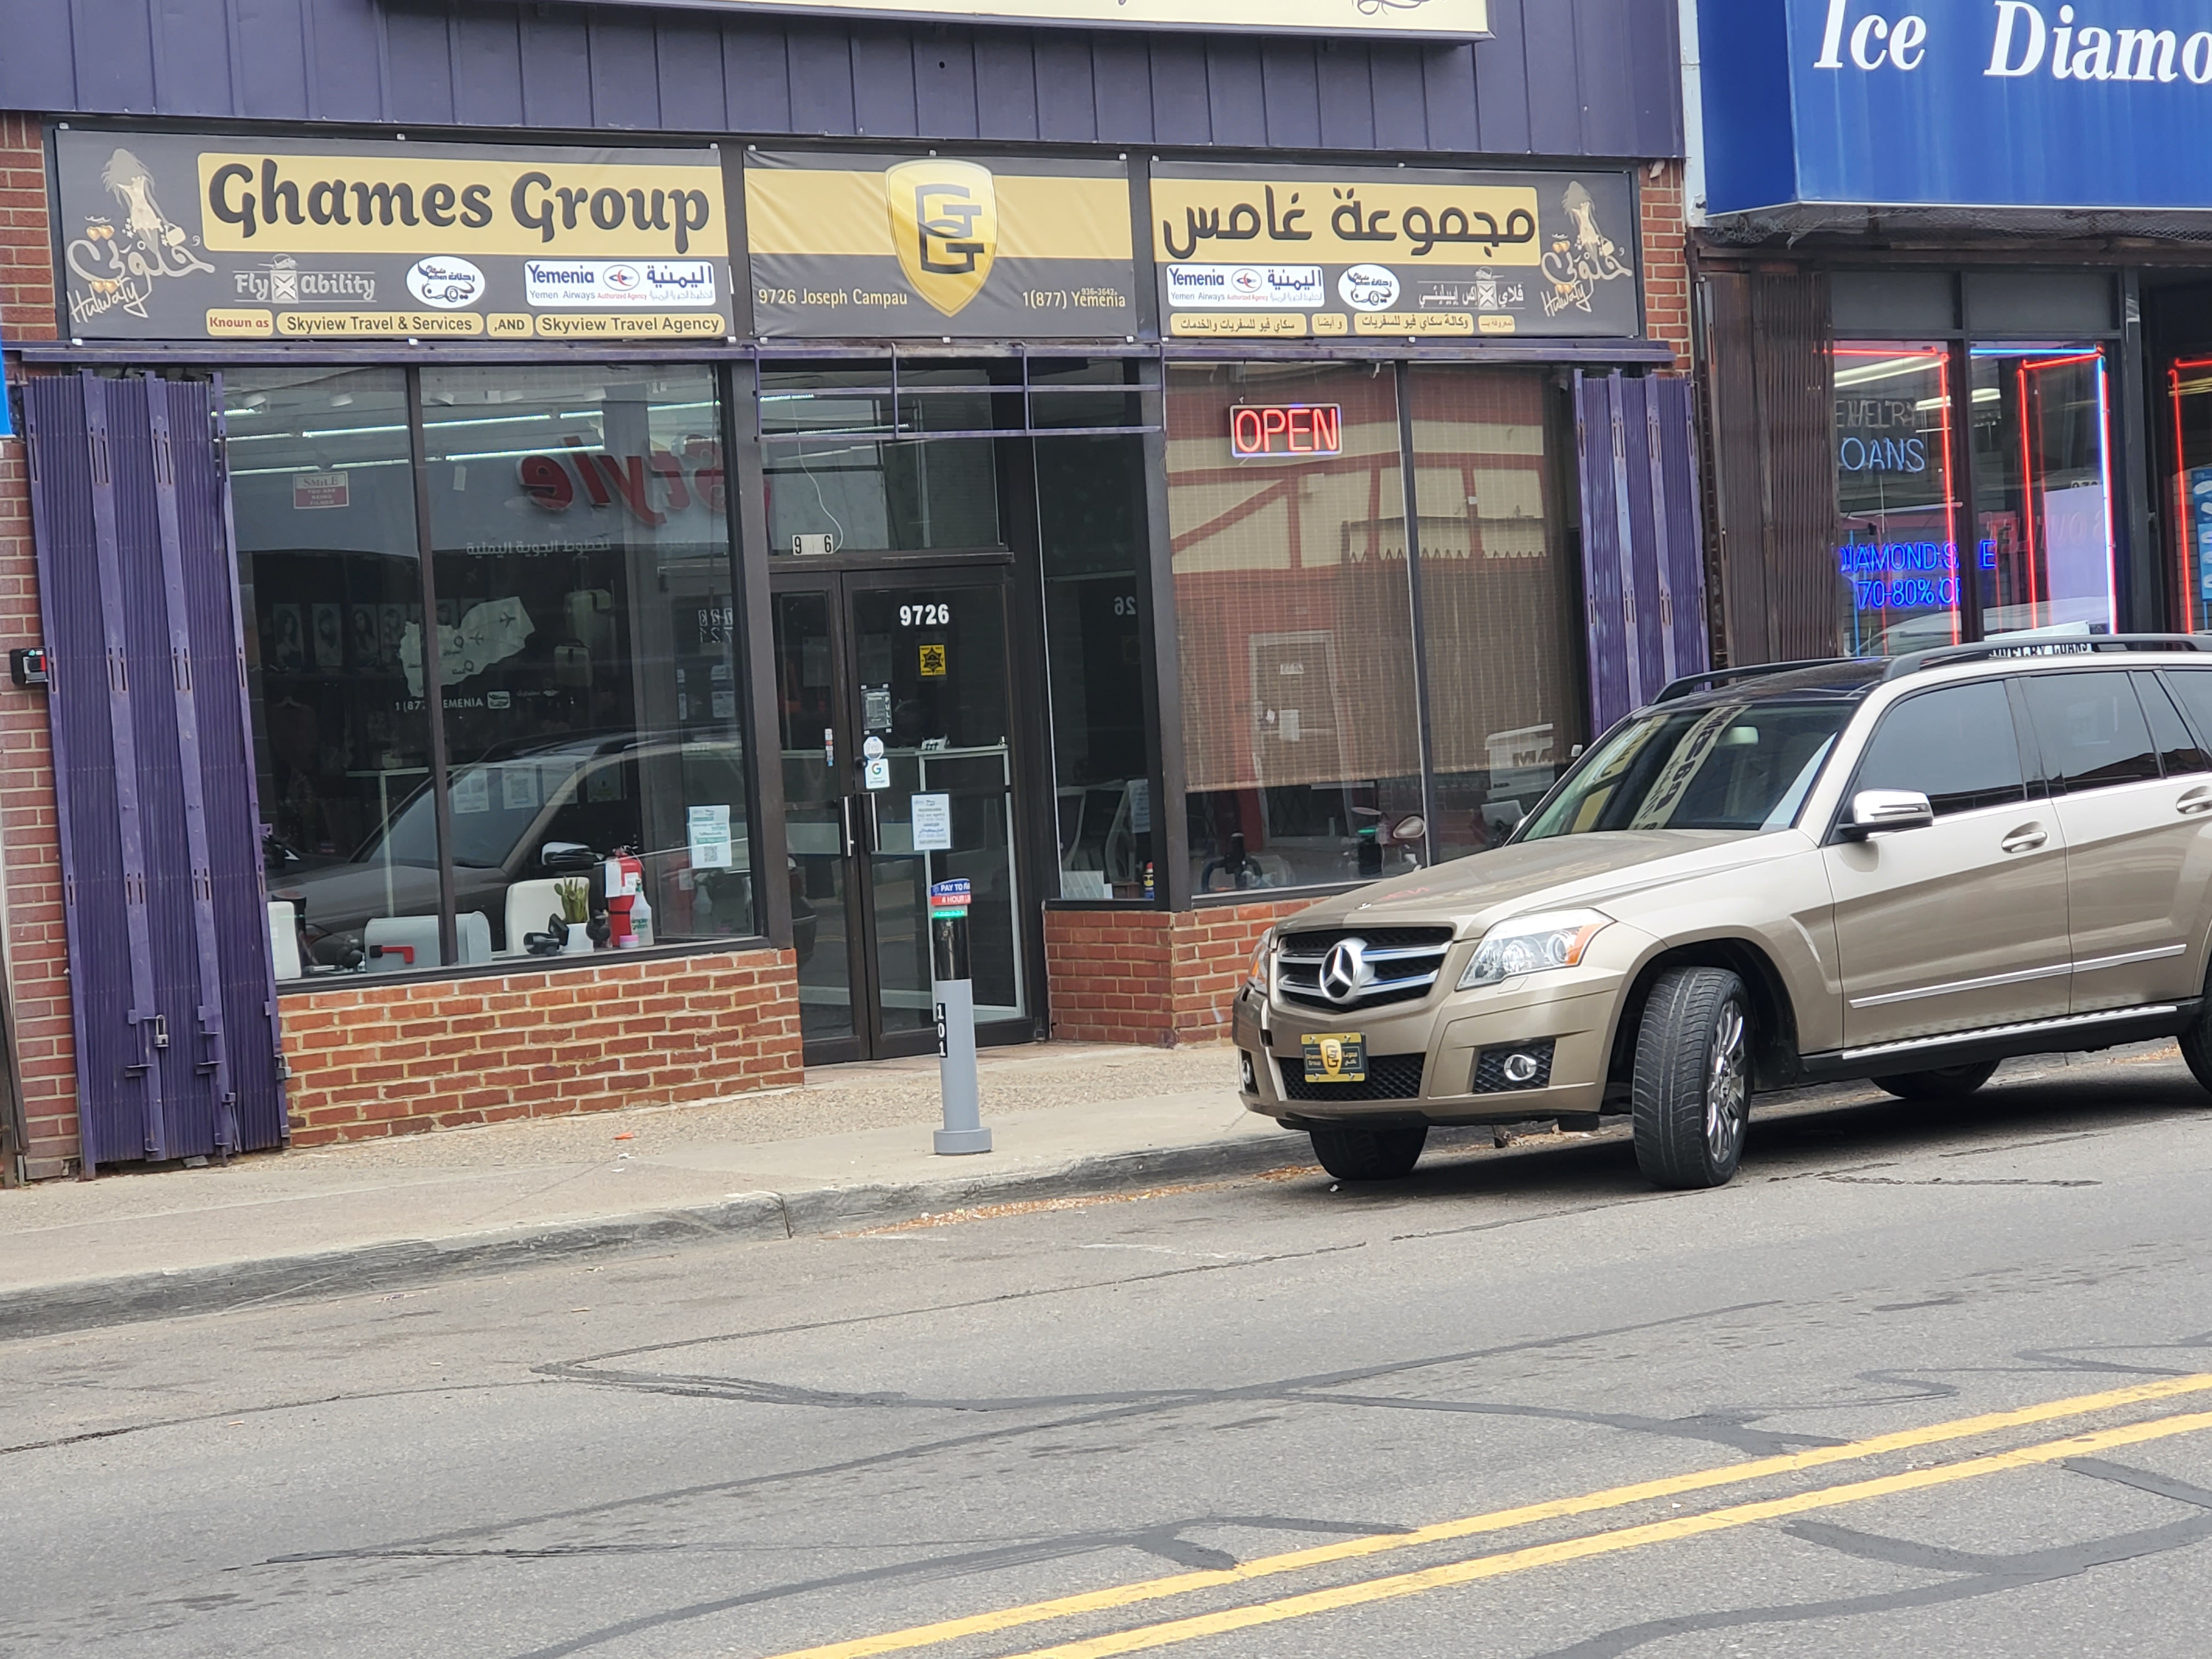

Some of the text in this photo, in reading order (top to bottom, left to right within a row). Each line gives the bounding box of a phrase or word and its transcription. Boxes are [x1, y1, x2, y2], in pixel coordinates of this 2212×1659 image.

[1813, 0, 1927, 70] Ice
[209, 158, 709, 254] Ghames Group
[1163, 184, 1536, 259] مجموعة غامس
[527, 264, 595, 284] Yemenia
[647, 264, 713, 288] اليمنية
[1169, 268, 1224, 286] Yemenia
[1267, 269, 1322, 291] اليمنية
[234, 273, 269, 300] Fly
[530, 290, 596, 301] Yemen Airways
[628, 292, 647, 301] Agency
[758, 289, 907, 309] 9726 Joseph Campau
[1022, 291, 1126, 309] 1(877) Yemenia
[1171, 291, 1225, 302] Yemen Airways
[209, 317, 269, 329] Known as
[287, 315, 472, 334] Skyview Travel & Services
[542, 317, 719, 334] Skyview Travel Agency
[1274, 318, 1295, 334] سكاي
[1420, 315, 1442, 330] سكاي
[1444, 314, 1469, 329] وكالة
[1836, 399, 1917, 429] EWELRY
[1234, 408, 1338, 454] OPEN
[1839, 437, 1925, 472] OANS
[1857, 578, 1934, 610] 70-80%
[899, 604, 950, 626] 9726
[443, 698, 483, 709] EMENIA
[941, 884, 953, 892] PAY
[954, 883, 963, 891] TO
[947, 895, 964, 903] HOUR
[937, 1003, 946, 1057] 101
